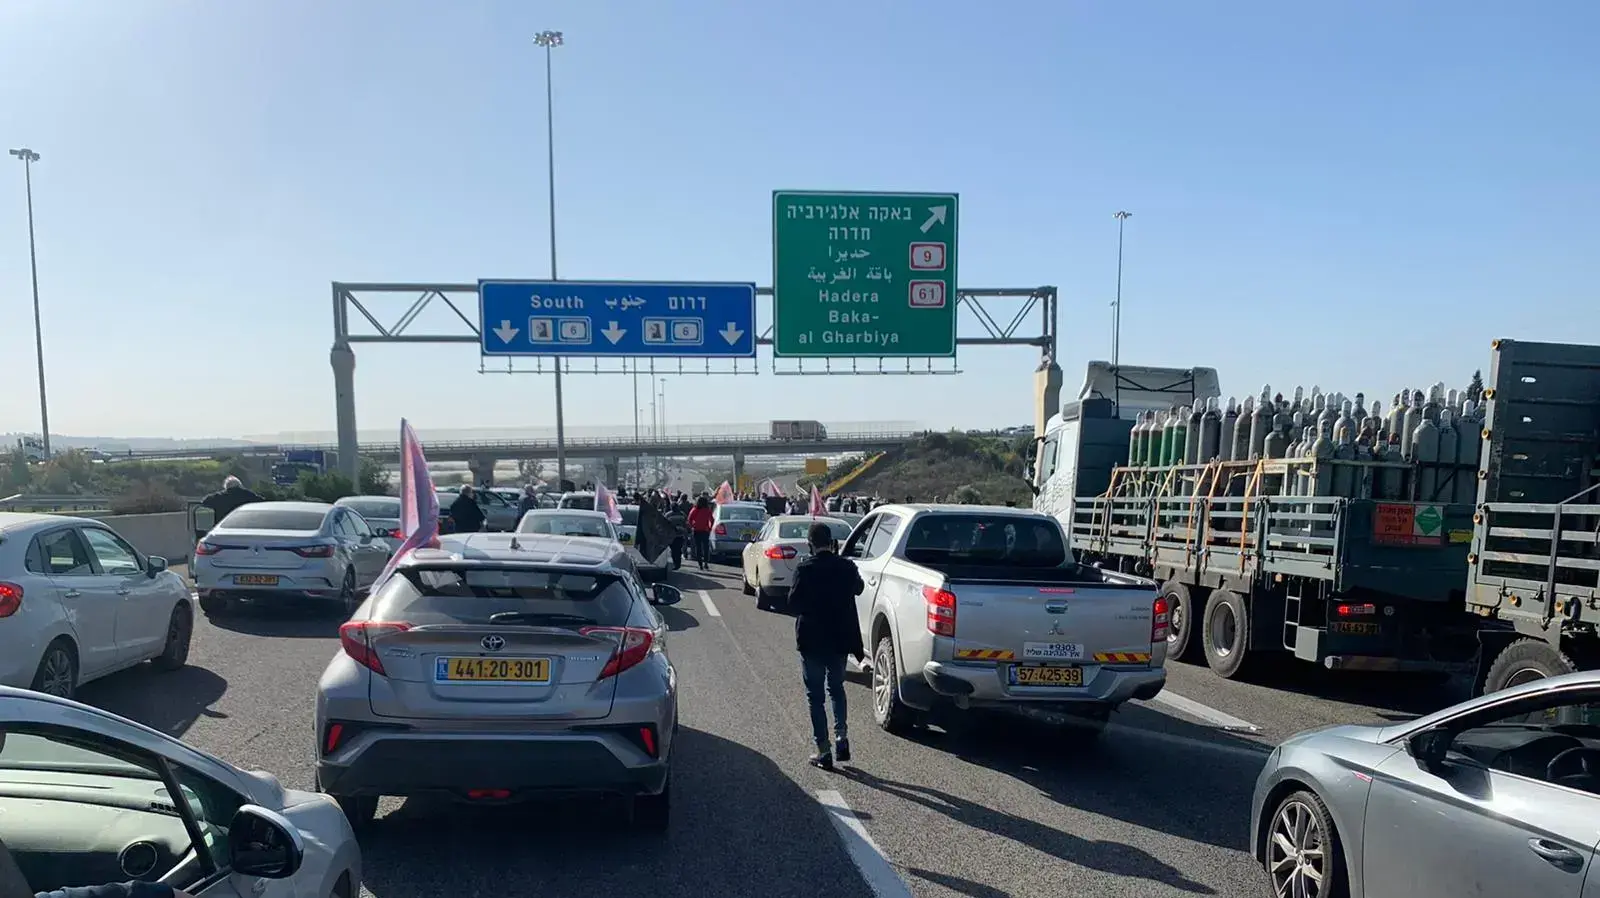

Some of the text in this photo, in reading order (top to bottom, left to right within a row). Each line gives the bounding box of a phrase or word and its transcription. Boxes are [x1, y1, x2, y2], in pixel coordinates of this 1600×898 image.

[868, 206, 913, 222] באקה
[829, 226, 871, 240] חדרה
[828, 245, 871, 262] حديرا
[923, 250, 932, 263] 9
[807, 266, 893, 285] باقة الغربية
[818, 289, 879, 303] Hadera
[918, 288, 935, 301] 61
[530, 295, 584, 309] South
[605, 294, 647, 312] جنوب
[668, 295, 707, 310] דרום
[829, 310, 880, 324] Baka-
[570, 326, 577, 336] 6
[682, 326, 690, 337] 6
[798, 330, 899, 347] al Gharbiya
